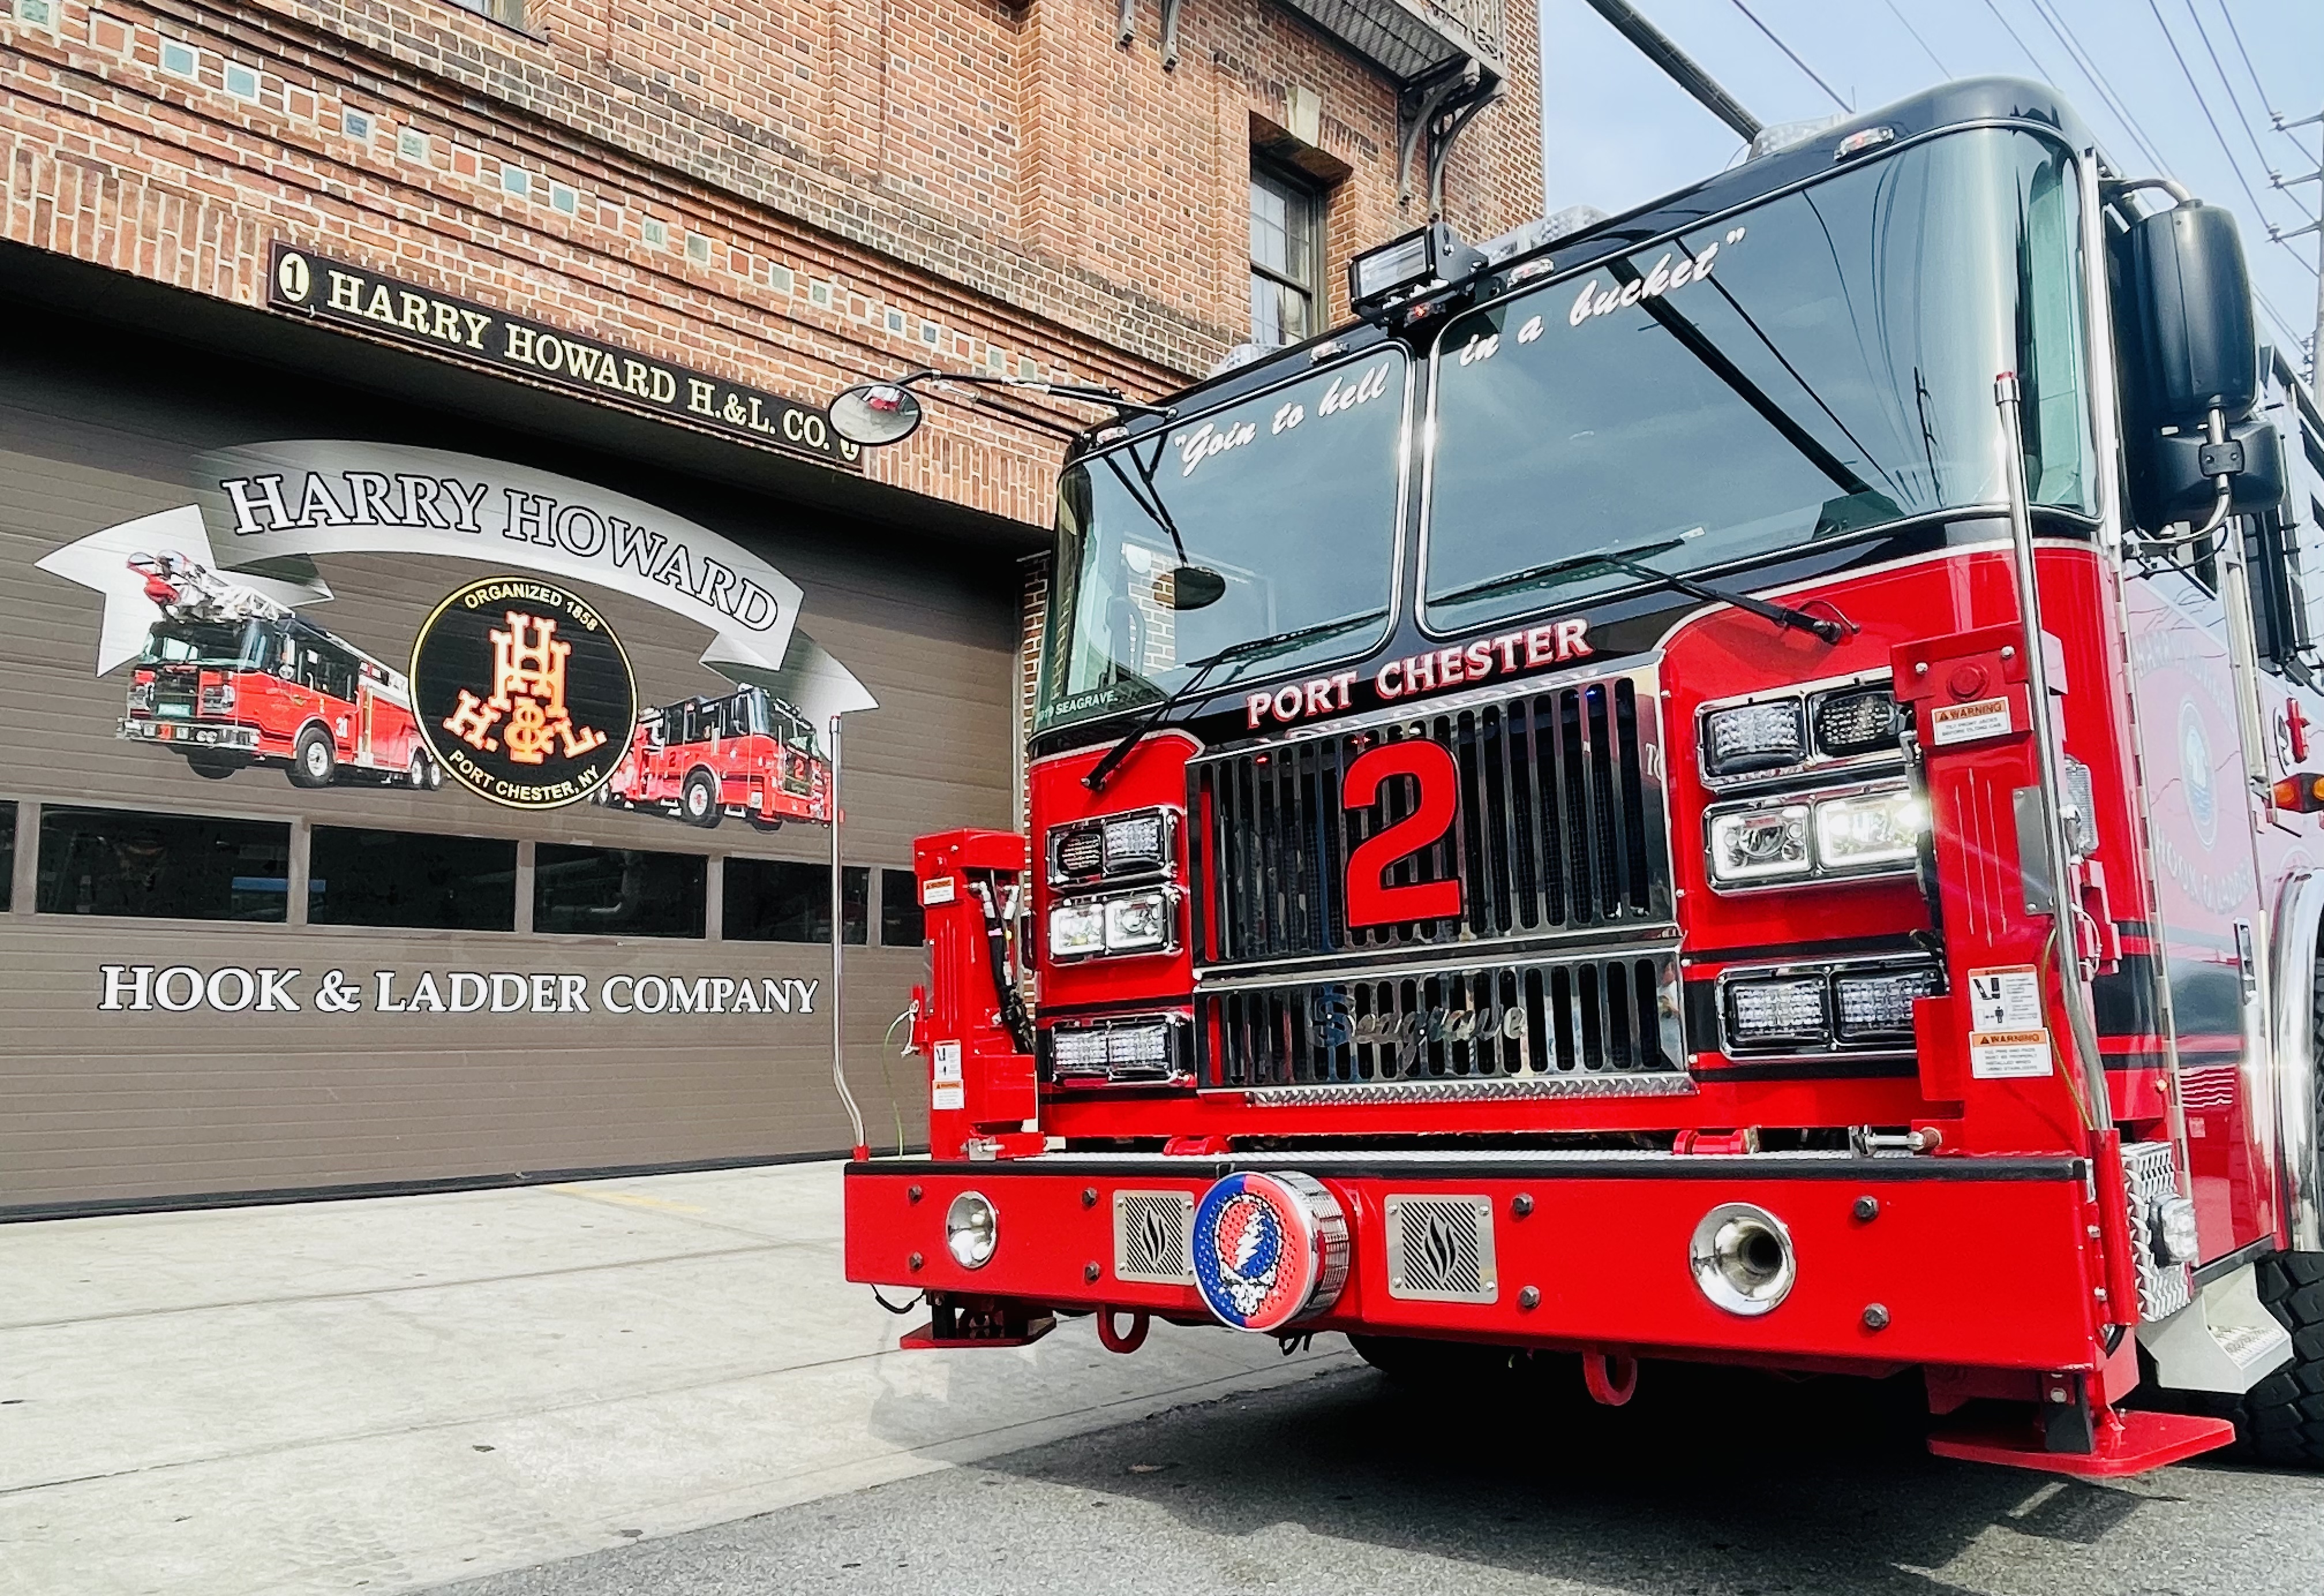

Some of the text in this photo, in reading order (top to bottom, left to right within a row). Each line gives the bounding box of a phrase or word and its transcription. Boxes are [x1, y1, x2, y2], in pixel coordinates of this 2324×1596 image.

[326, 269, 492, 350] HARRY
[503, 323, 677, 404] HOWARD
[687, 378, 775, 435] H.&L.
[783, 409, 830, 450] CO.
[1459, 333, 1499, 367] in
[1517, 315, 1544, 344] a
[1272, 401, 1304, 435] to
[1317, 361, 1390, 417] hell
[220, 470, 781, 633] HARRY HOWARD
[464, 584, 599, 631] ORGANIZED 1858
[1246, 618, 1595, 730] PORT CHESTER
[1950, 701, 2002, 719] WARNING
[449, 750, 496, 788] PORT
[577, 764, 600, 788] NY
[794, 758, 805, 780] 2
[1343, 739, 1461, 928] 2
[97, 964, 819, 1014] HOOK & LADDER COMPANY
